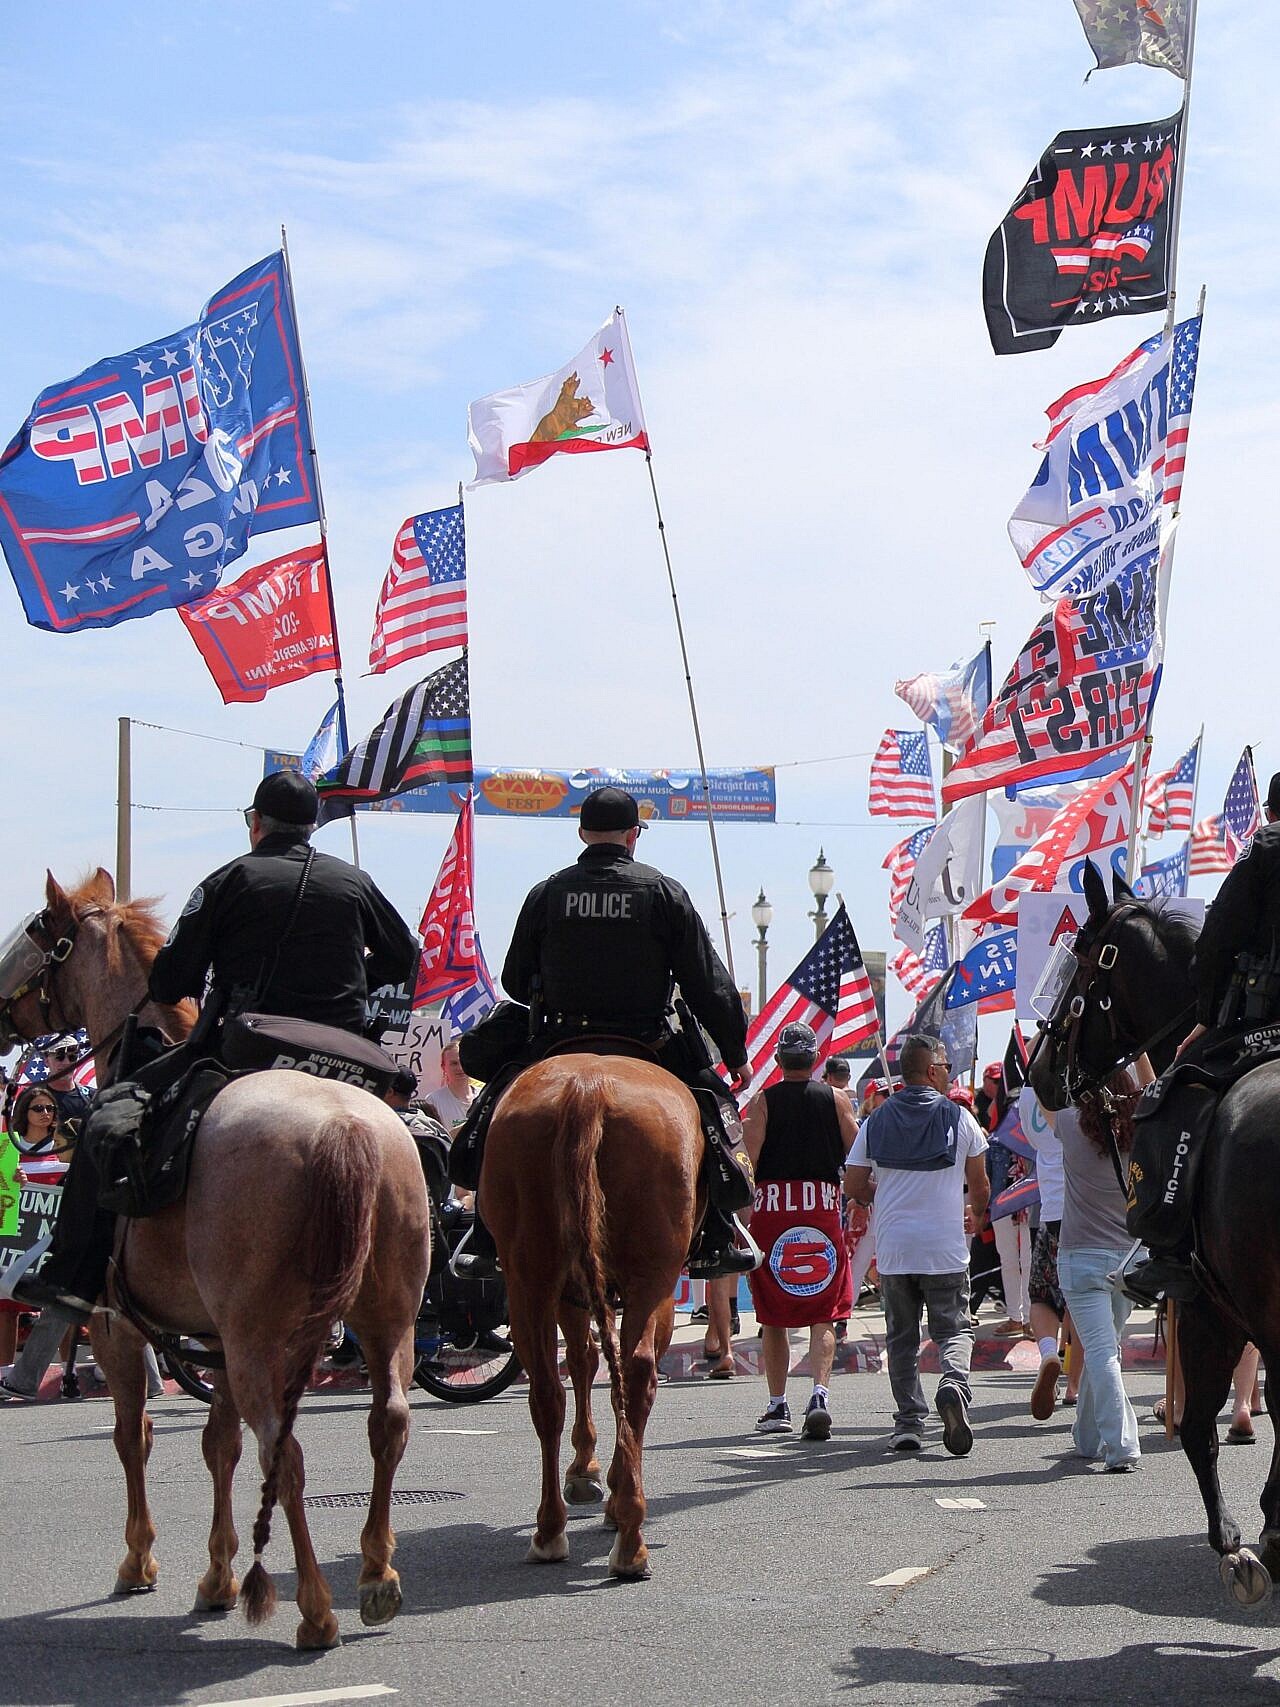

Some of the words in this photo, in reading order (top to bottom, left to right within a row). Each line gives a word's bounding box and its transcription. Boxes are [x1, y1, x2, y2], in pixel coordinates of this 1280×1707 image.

[506, 799, 544, 809] FEST
[566, 892, 632, 919] POLICE
[308, 1053, 366, 1074] MOUNTED
[1164, 1131, 1191, 1205] POLICE
[780, 1242, 832, 1285] 5
